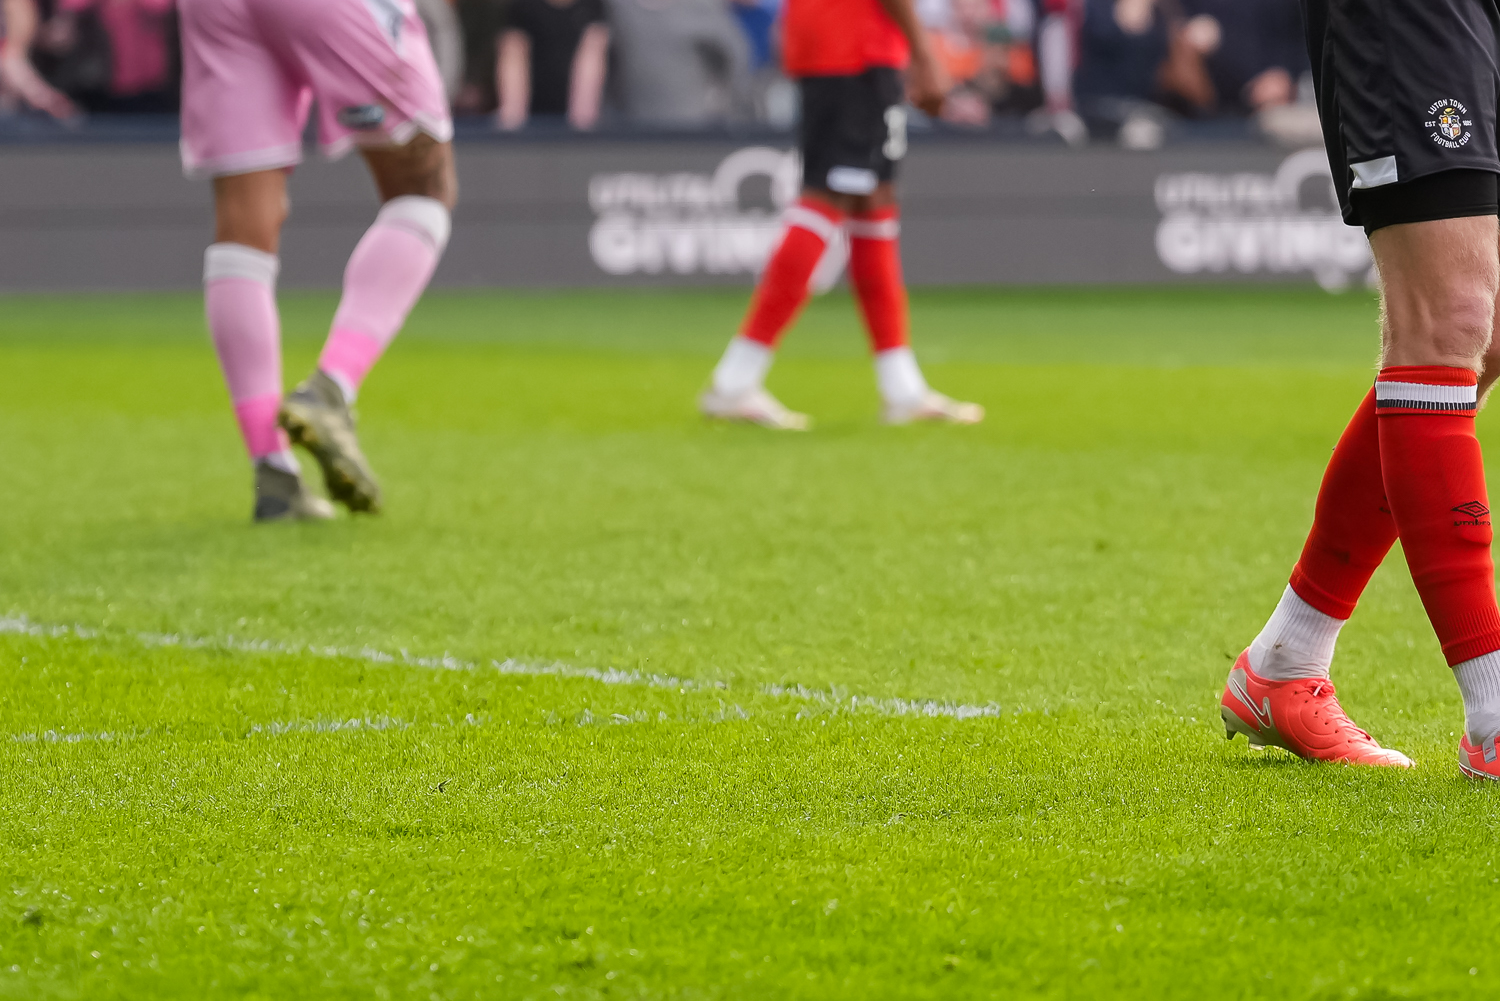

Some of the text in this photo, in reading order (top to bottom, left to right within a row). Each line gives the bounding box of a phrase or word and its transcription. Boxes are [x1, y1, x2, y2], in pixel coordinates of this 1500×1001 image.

[1428, 98, 1467, 115] LUTON TOWN
[1430, 131, 1471, 148] FOOTBALL CLUB
